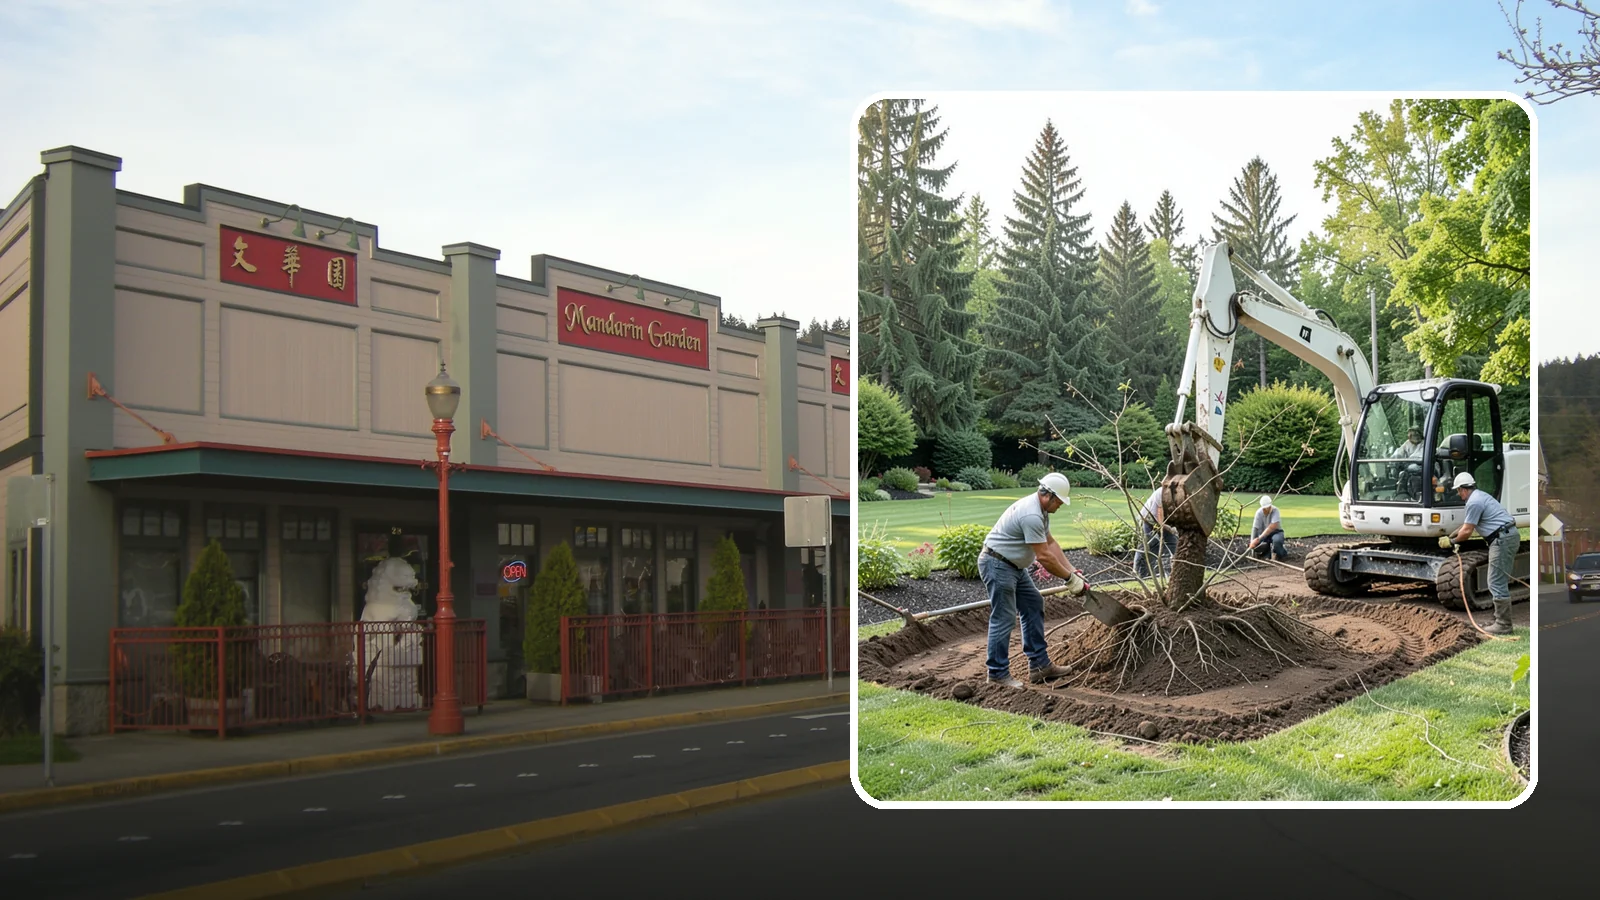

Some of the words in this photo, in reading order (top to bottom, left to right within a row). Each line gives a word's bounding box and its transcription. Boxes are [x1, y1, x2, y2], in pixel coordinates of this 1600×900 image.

[230, 235, 346, 291] 文華園
[564, 302, 644, 341] Mandarin
[648, 320, 701, 352] Garden
[503, 565, 527, 578] OPEN
